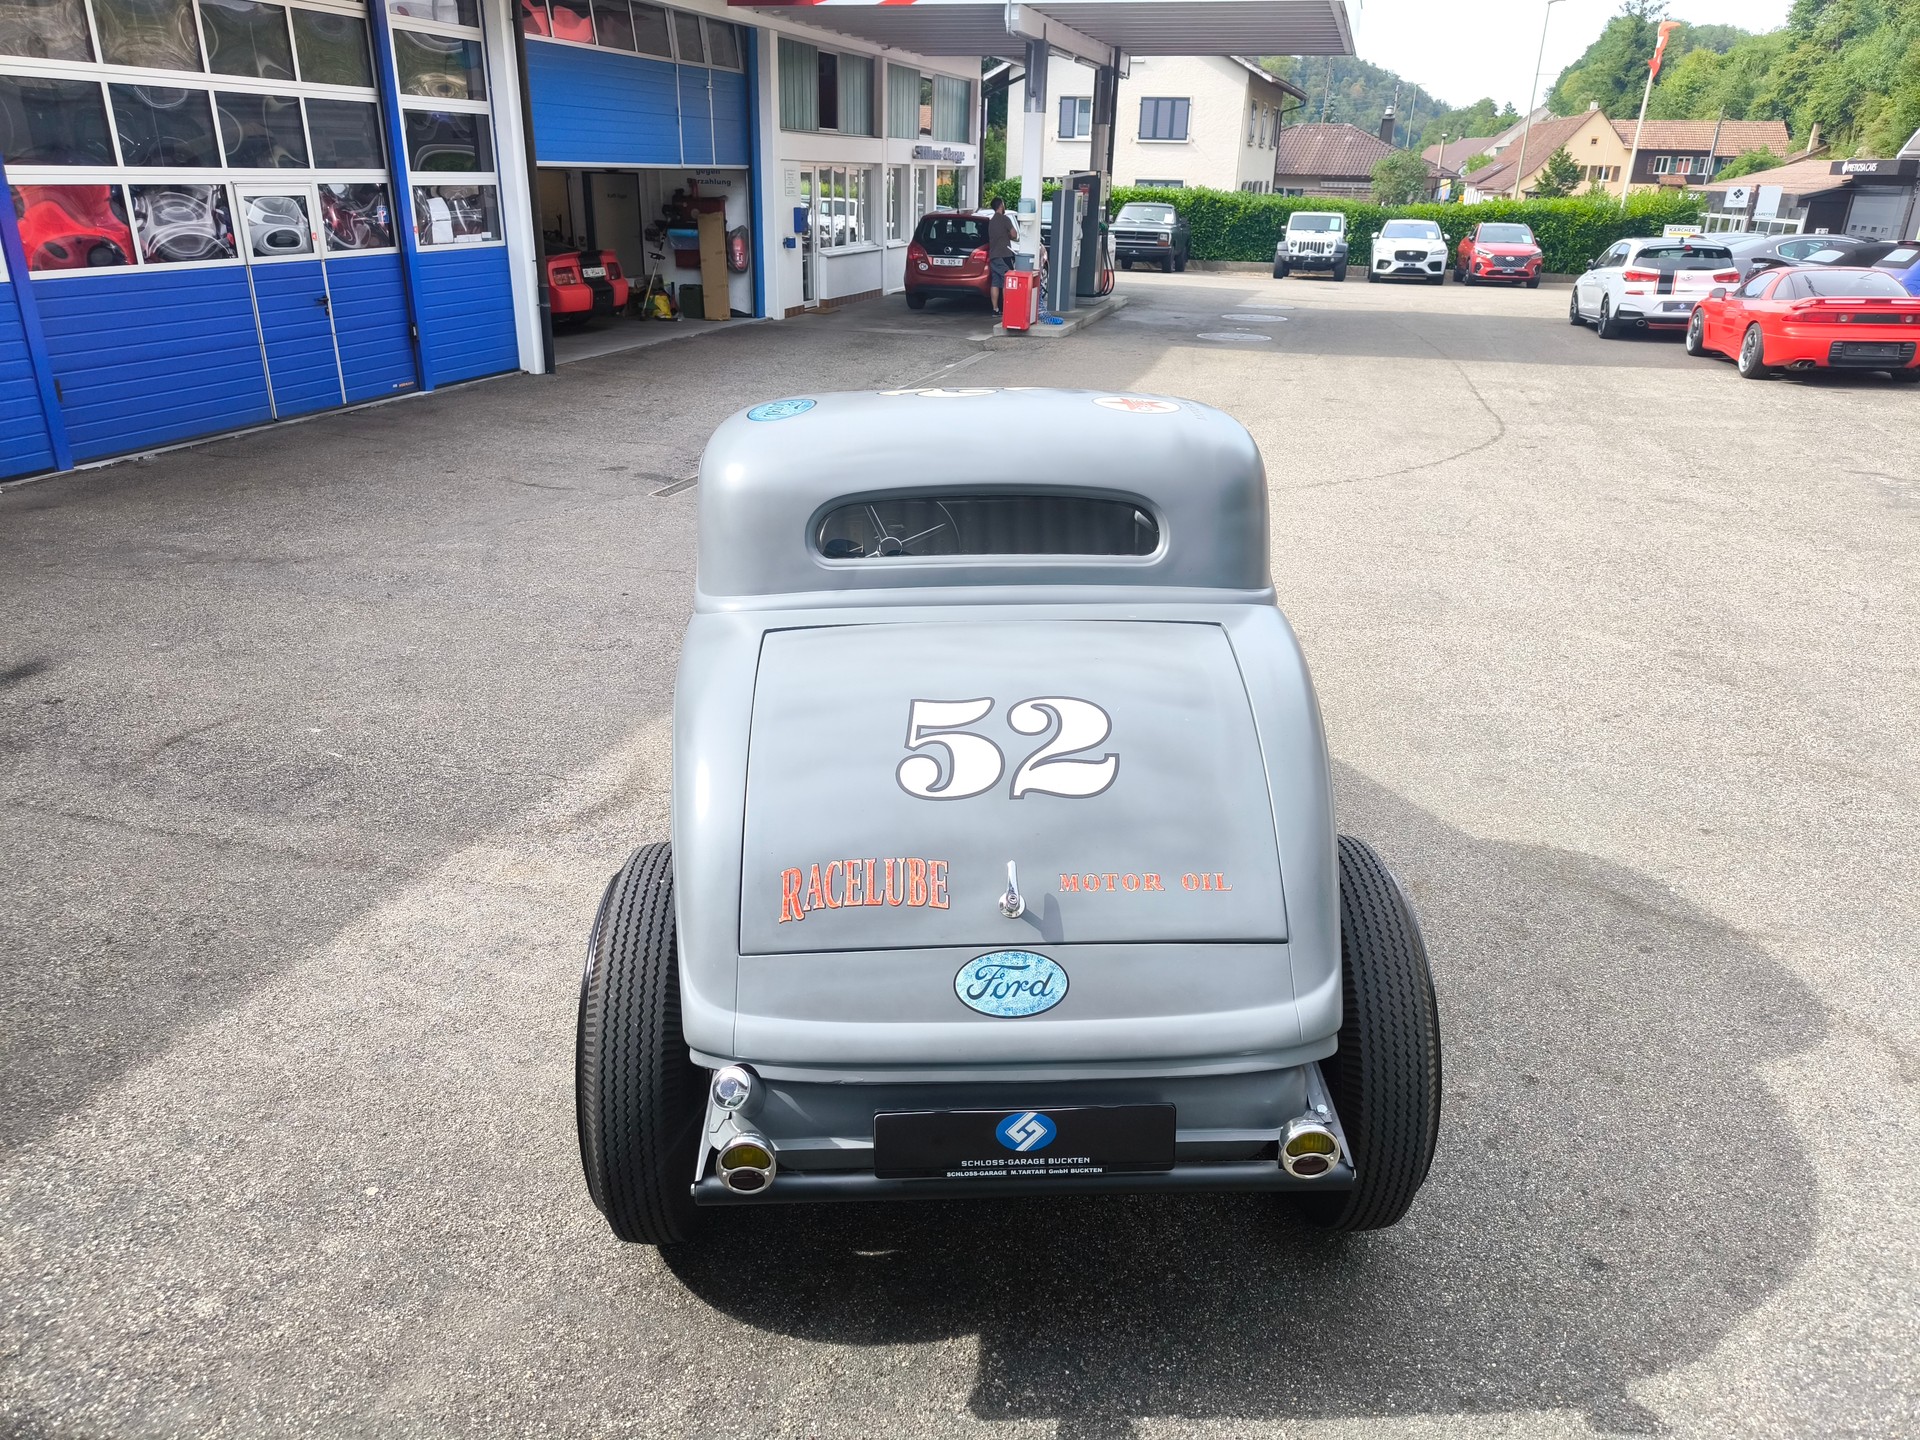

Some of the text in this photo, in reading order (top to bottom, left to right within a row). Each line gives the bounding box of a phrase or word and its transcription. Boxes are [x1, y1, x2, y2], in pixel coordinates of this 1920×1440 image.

[895, 695, 1120, 801] 52
[778, 857, 1233, 924] RACELUBE MOTOR OIL
[966, 964, 1055, 1000] Ford
[946, 1169, 1008, 1178] SCHLOSS-GARAGE
[1010, 1168, 1047, 1176] M.TARTARI
[1070, 1167, 1103, 1175] BUCKTEN
[961, 1156, 1091, 1167] SCHLOSS-GARAGE BUCKTEN
